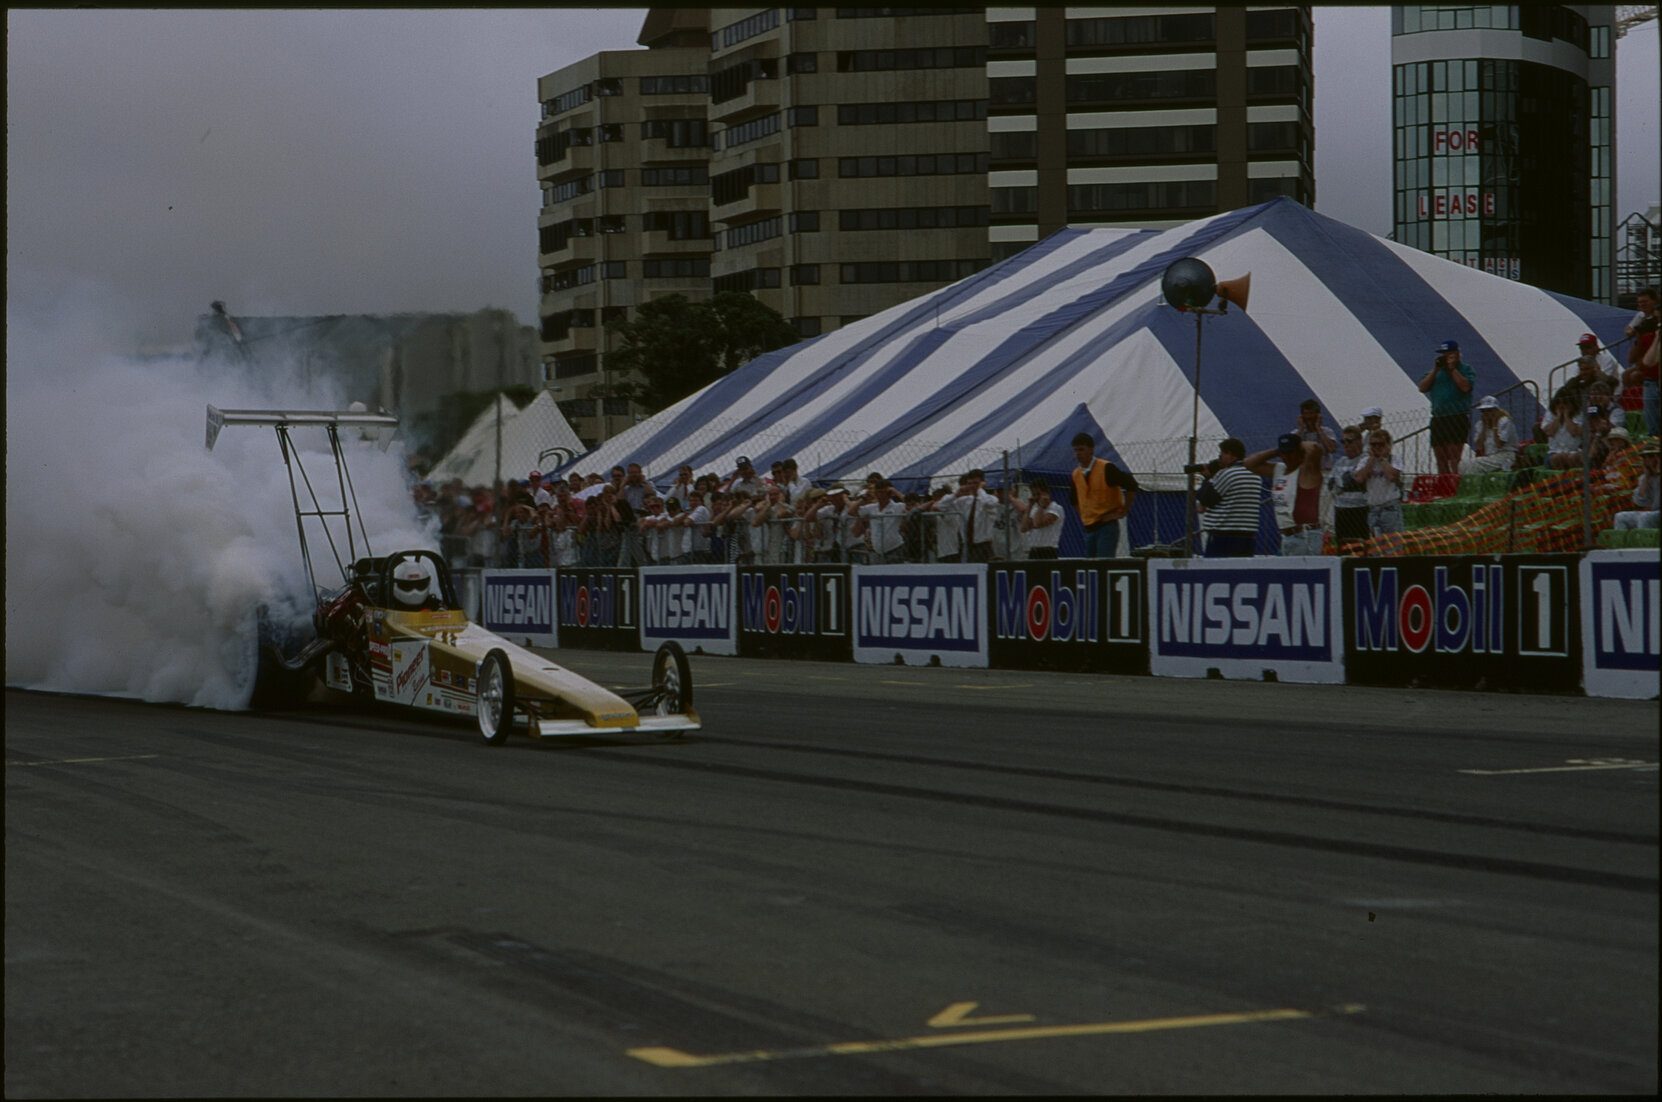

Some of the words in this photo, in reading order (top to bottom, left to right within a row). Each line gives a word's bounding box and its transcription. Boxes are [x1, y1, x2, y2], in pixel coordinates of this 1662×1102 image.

[1435, 130, 1479, 151] FOR
[1419, 193, 1495, 216] LEASE
[487, 584, 550, 625] NISSAN
[561, 574, 614, 629] Mobil
[622, 578, 631, 625] 1
[646, 583, 728, 629] NISSAN
[742, 572, 815, 635] Mobil
[826, 577, 837, 631] 1
[860, 585, 975, 640] NISSAN
[995, 569, 1099, 643] Mobil
[1115, 575, 1130, 637] 1
[1161, 582, 1325, 647] NISSAN
[1354, 564, 1504, 654] Mobil
[1532, 572, 1551, 650] 1
